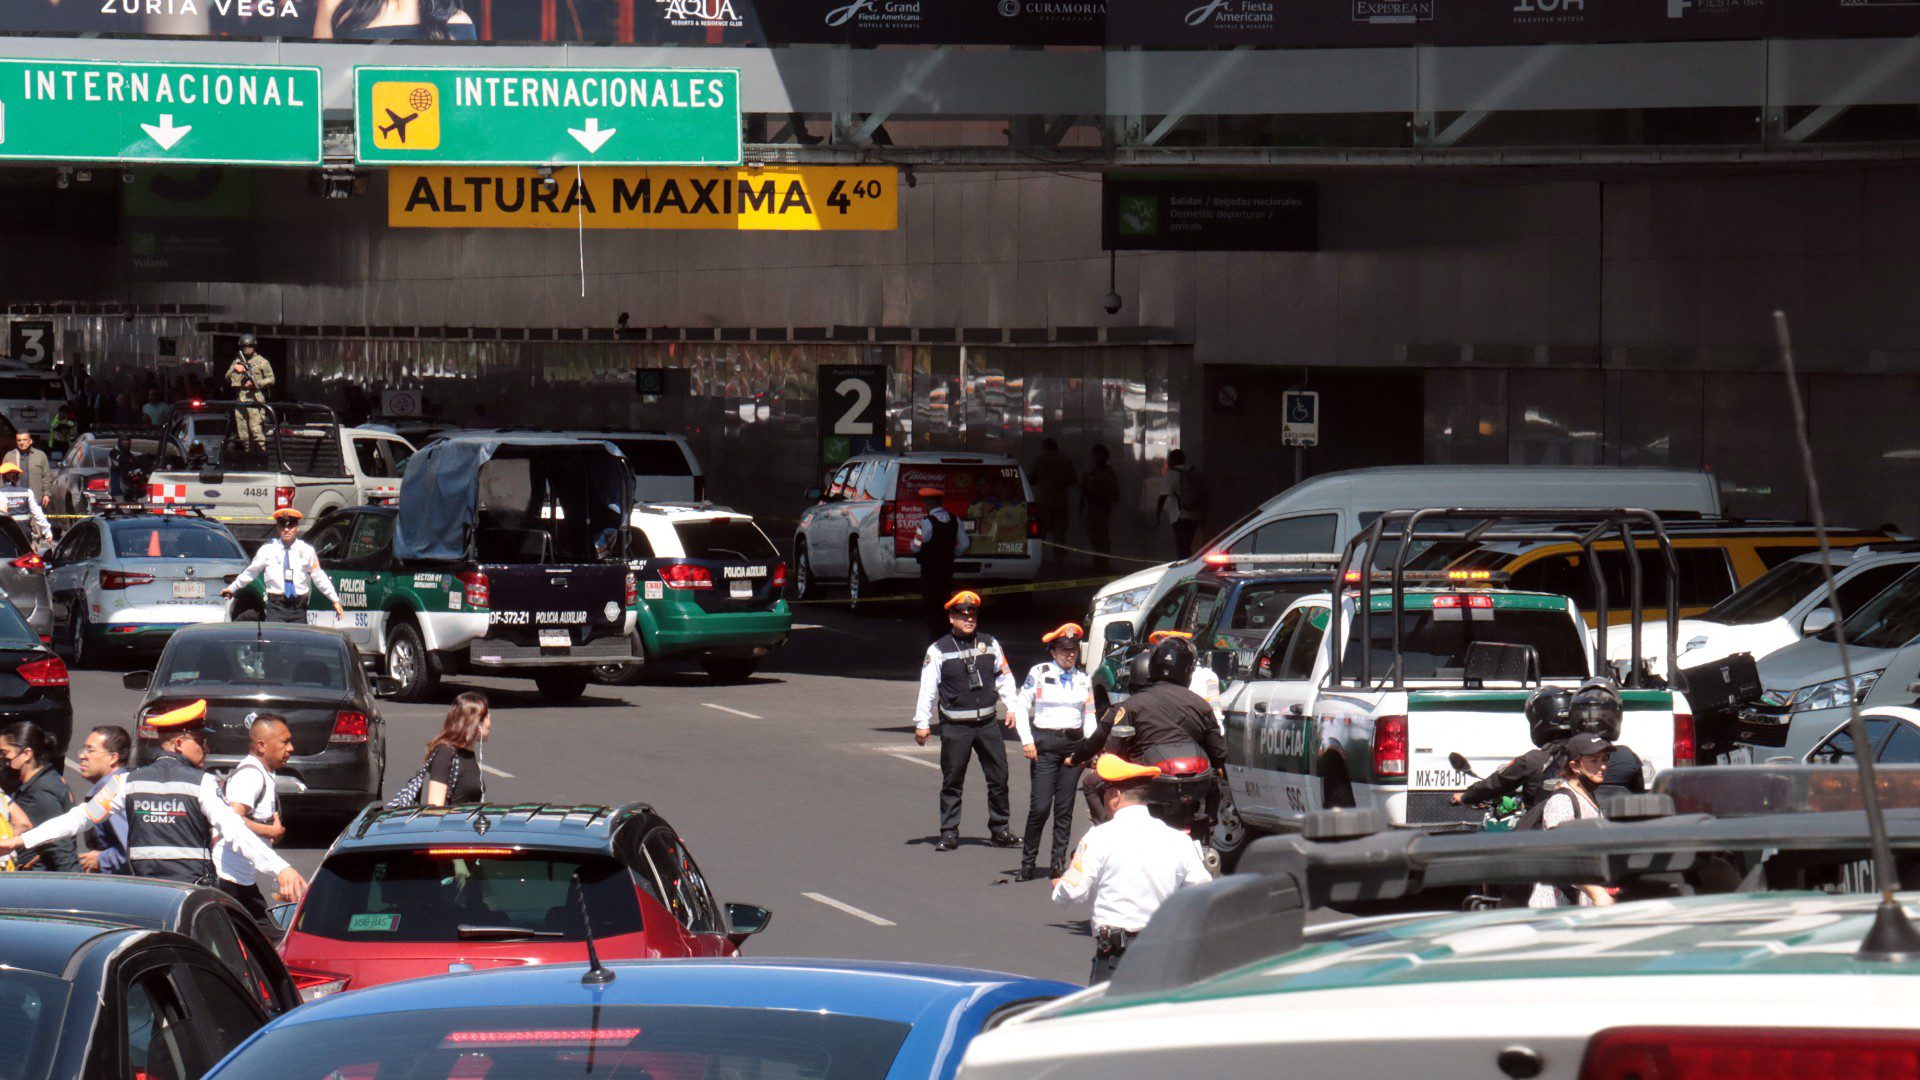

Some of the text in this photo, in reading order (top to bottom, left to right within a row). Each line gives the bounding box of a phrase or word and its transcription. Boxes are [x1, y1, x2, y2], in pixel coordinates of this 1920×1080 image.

[101, 0, 299, 18] ZURIA VEGA
[885, 1, 920, 12] Grand
[1026, 3, 1106, 13] CURAMORIA
[1242, 1, 1273, 11] Fiesta
[859, 13, 920, 21] Fiesta Americana
[1215, 12, 1273, 22] Americana
[24, 69, 304, 107] INTERNACIONAL
[455, 76, 724, 109] INTERNACIONALES
[404, 176, 596, 213] ALTURA
[612, 177, 813, 215] MAXIMA
[1170, 196, 1202, 206] Salidas
[1254, 197, 1302, 206] nacionales
[1170, 209, 1213, 218] Domestic
[132, 257, 169, 268] Volaris
[20, 328, 45, 365] 3
[834, 377, 874, 435] 2
[243, 487, 268, 497] 4484
[413, 573, 434, 582] SECTOR
[723, 565, 767, 578] POLICIA AUXILIAR
[340, 578, 366, 592] POLICIA
[338, 593, 367, 608] AUXILIAR
[355, 612, 369, 627] SSC
[489, 611, 529, 624] DF-372-Z1
[536, 610, 587, 623] POLICIA AUXILIAR
[1415, 769, 1467, 787] MX-781-D1
[134, 798, 187, 812] POLICÍA
[1286, 786, 1306, 813] SSC
[142, 814, 176, 824] CDMX
